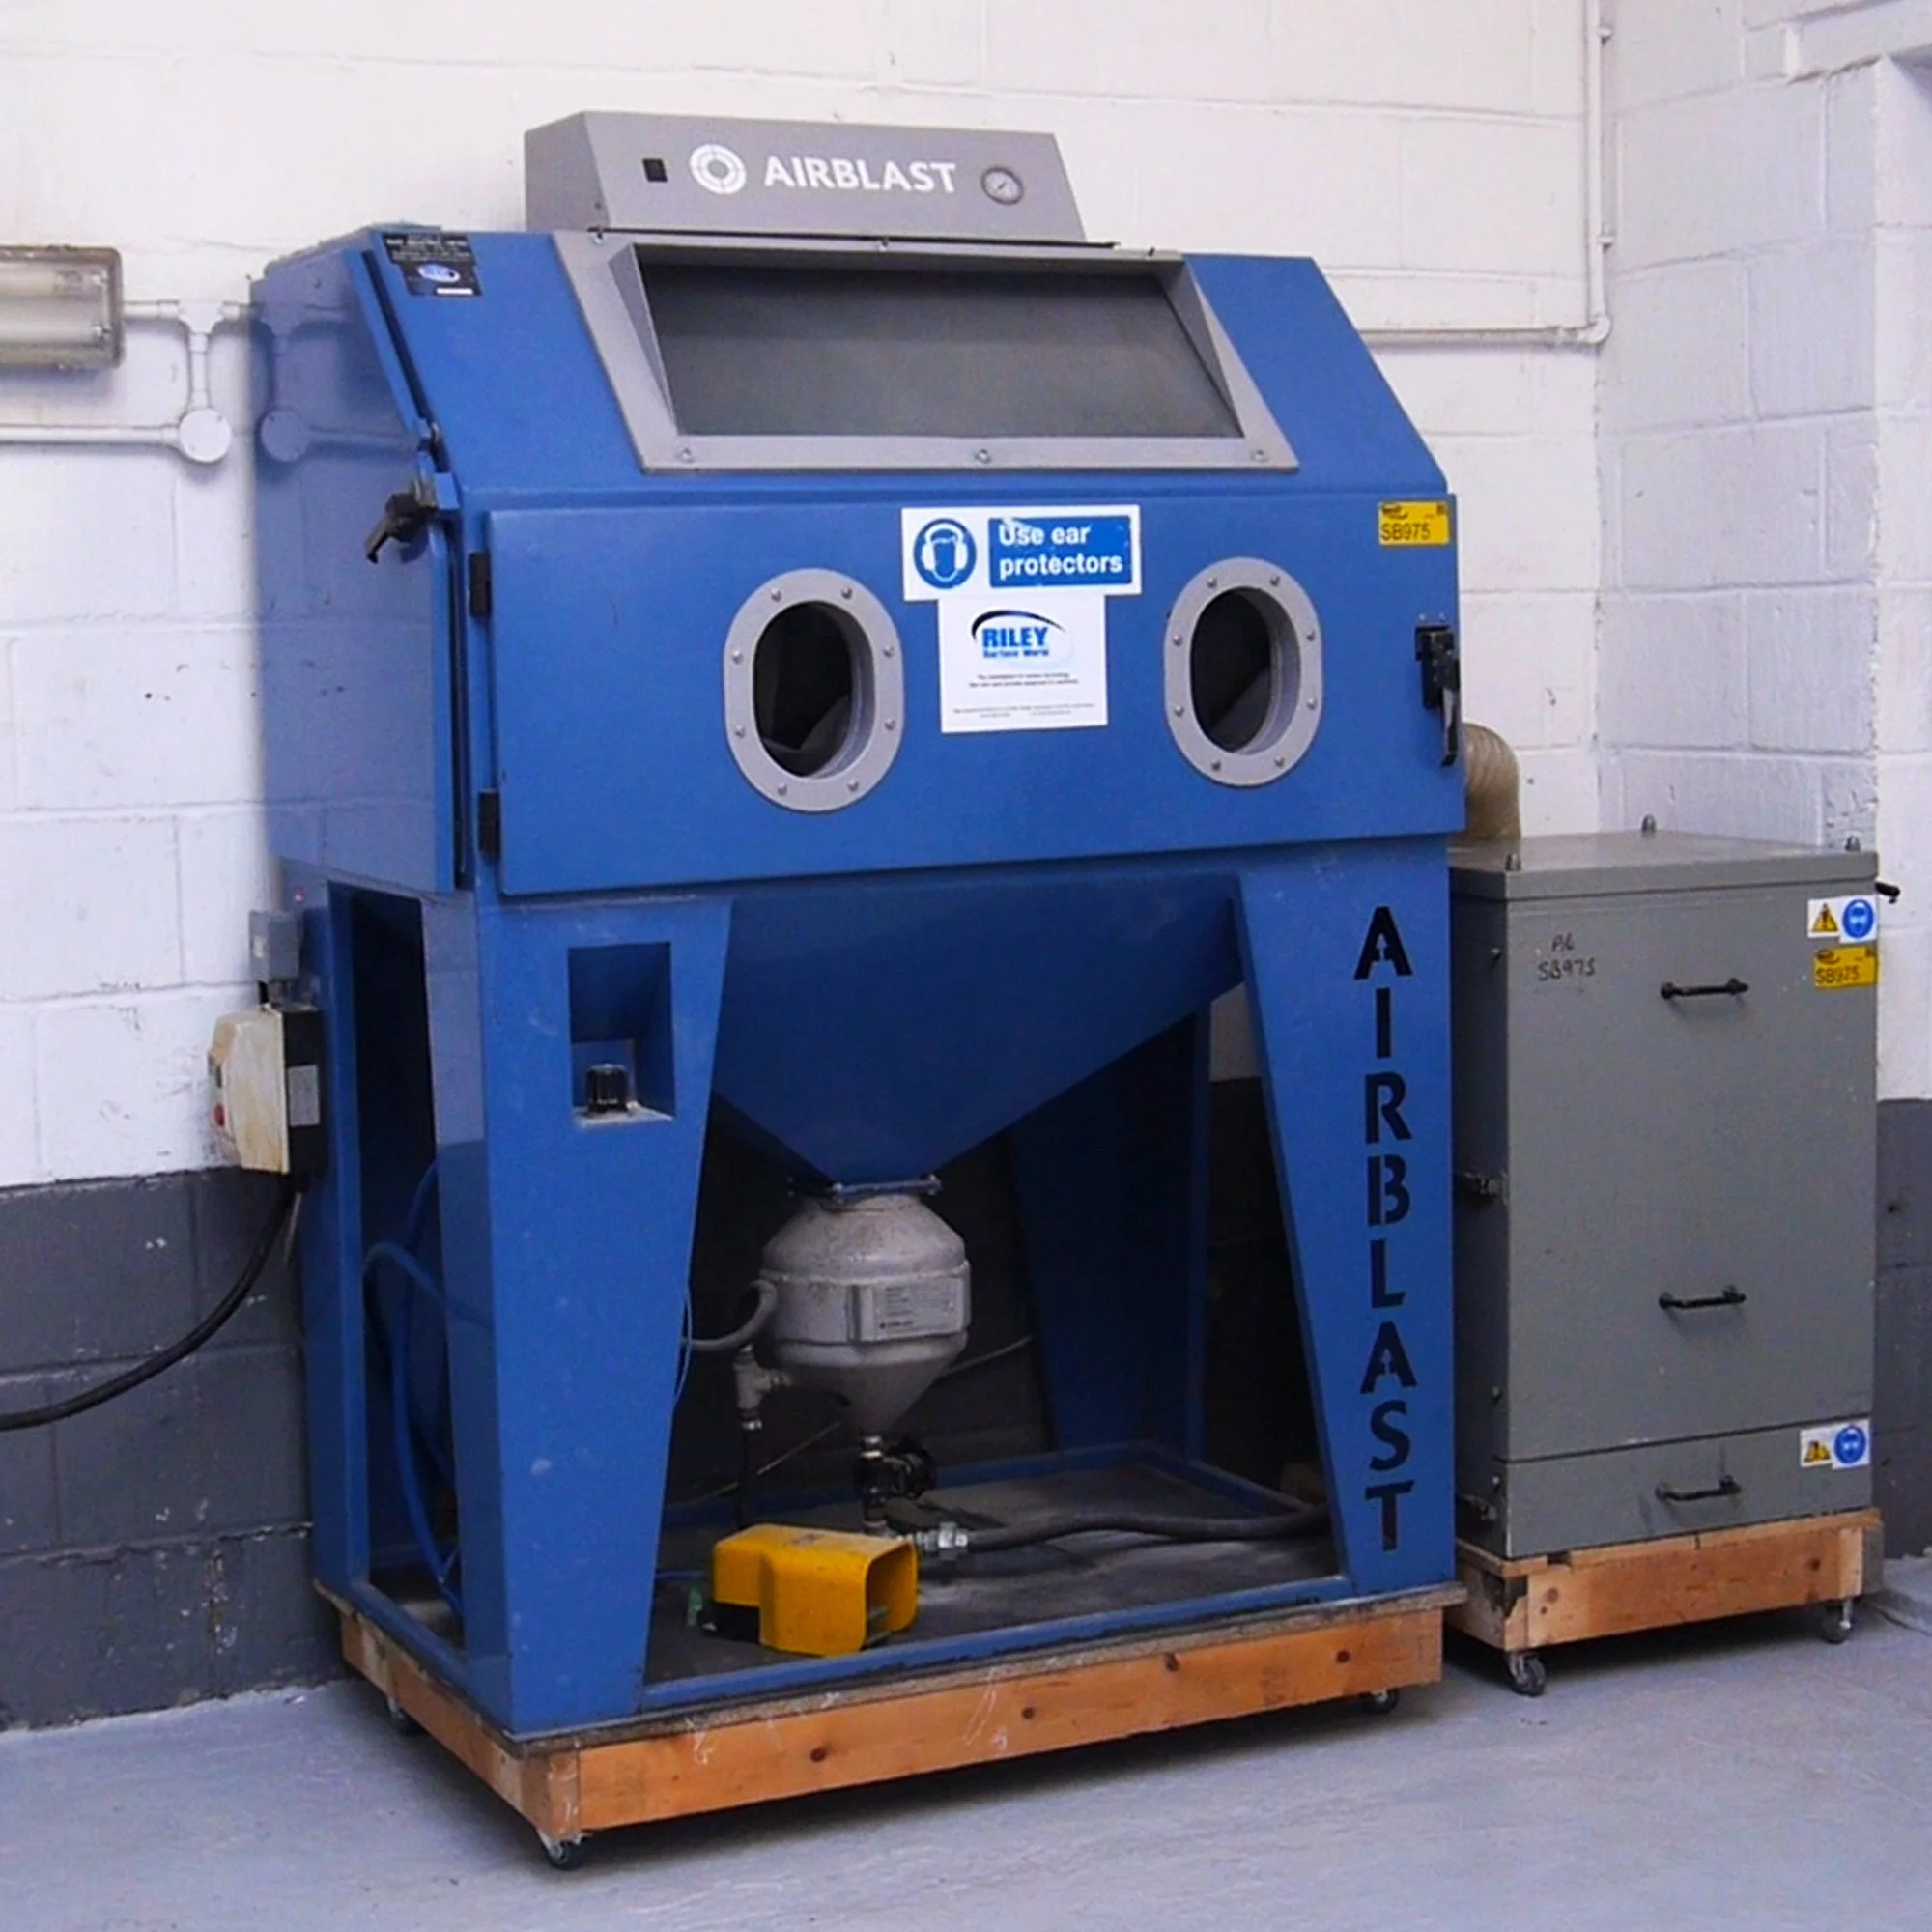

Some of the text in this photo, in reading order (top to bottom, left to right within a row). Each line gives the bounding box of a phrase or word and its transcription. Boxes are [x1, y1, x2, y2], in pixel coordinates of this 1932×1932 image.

[763, 155, 957, 195] AIRBLAST
[999, 524, 1091, 546] Use ear
[1380, 523, 1431, 541] SB975
[999, 552, 1123, 582] protectors
[981, 626, 1048, 647] RILEY
[1354, 906, 1418, 1552] AIRBLAST
